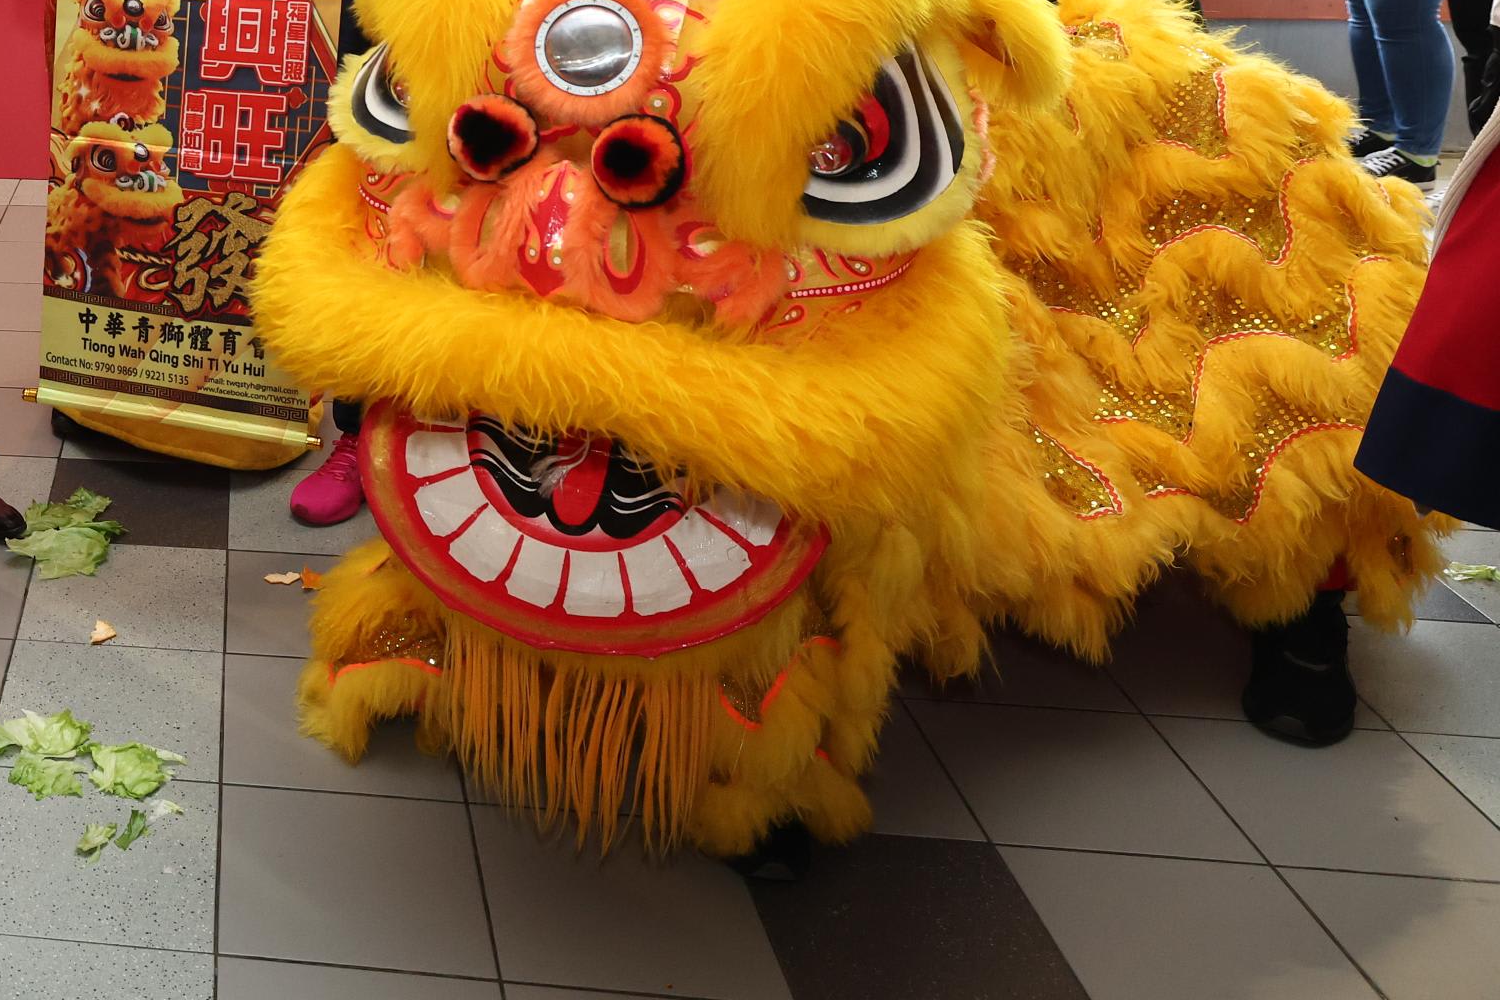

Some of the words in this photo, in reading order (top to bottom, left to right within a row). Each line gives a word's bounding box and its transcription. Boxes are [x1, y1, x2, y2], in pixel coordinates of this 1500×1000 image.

[45, 351, 78, 368] Contact
[78, 359, 93, 371] No:
[94, 362, 116, 374] 9790
[117, 364, 138, 377] 9869
[145, 369, 167, 382] 9221
[167, 372, 189, 386] 5135
[81, 337, 115, 358] Tiong
[119, 343, 146, 360] Wah
[149, 349, 179, 369] Qing
[183, 354, 204, 369] Shi
[207, 357, 219, 371] Ti
[222, 360, 239, 375] Yu
[242, 362, 265, 378] Hui
[203, 375, 225, 386] Email:
